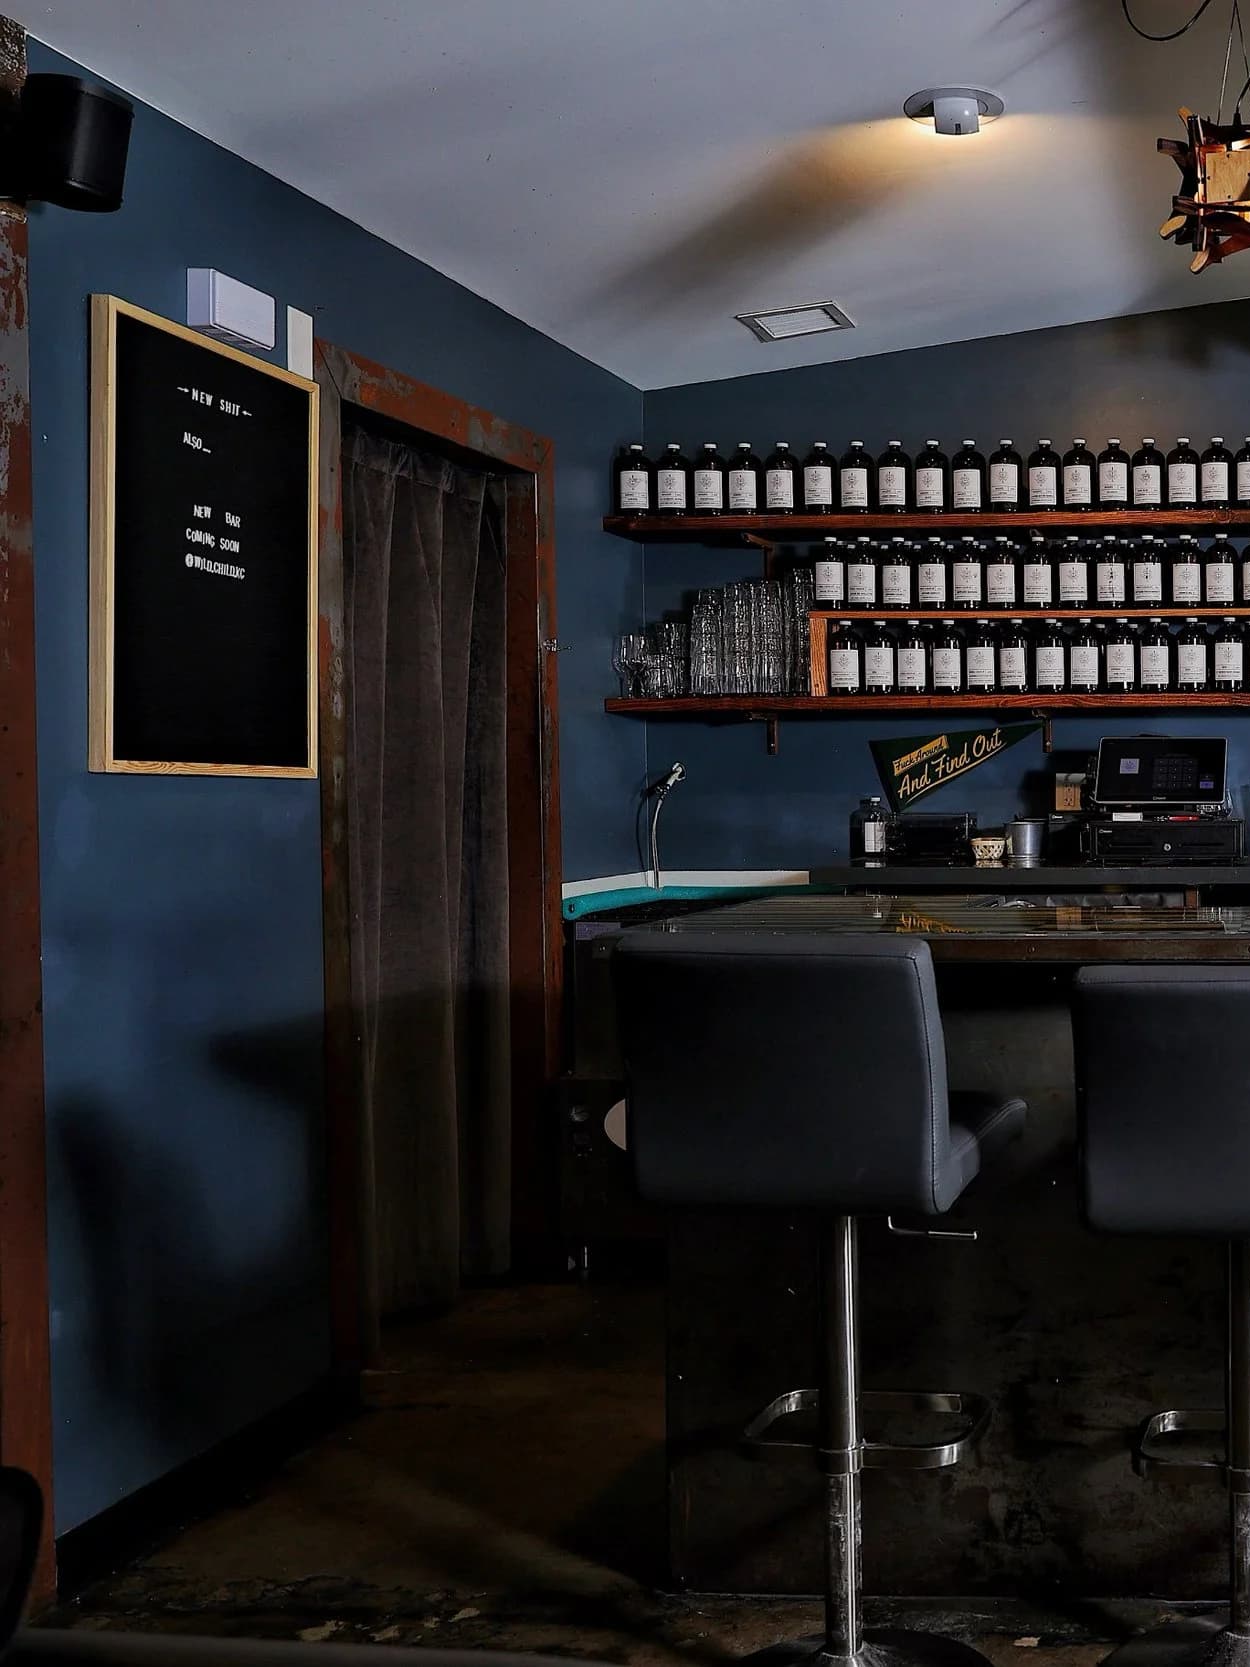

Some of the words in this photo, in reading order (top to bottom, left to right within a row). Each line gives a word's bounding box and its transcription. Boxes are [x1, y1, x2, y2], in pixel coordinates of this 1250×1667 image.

[192, 387, 213, 406] NEW
[220, 399, 241, 416] SHIT
[193, 504, 212, 519] NEW
[225, 511, 241, 528] BAR
[185, 527, 216, 548] COMING
[220, 537, 240, 553] SOON
[898, 763, 931, 799] And
[931, 742, 970, 778] Find
[973, 728, 1003, 757] Out
